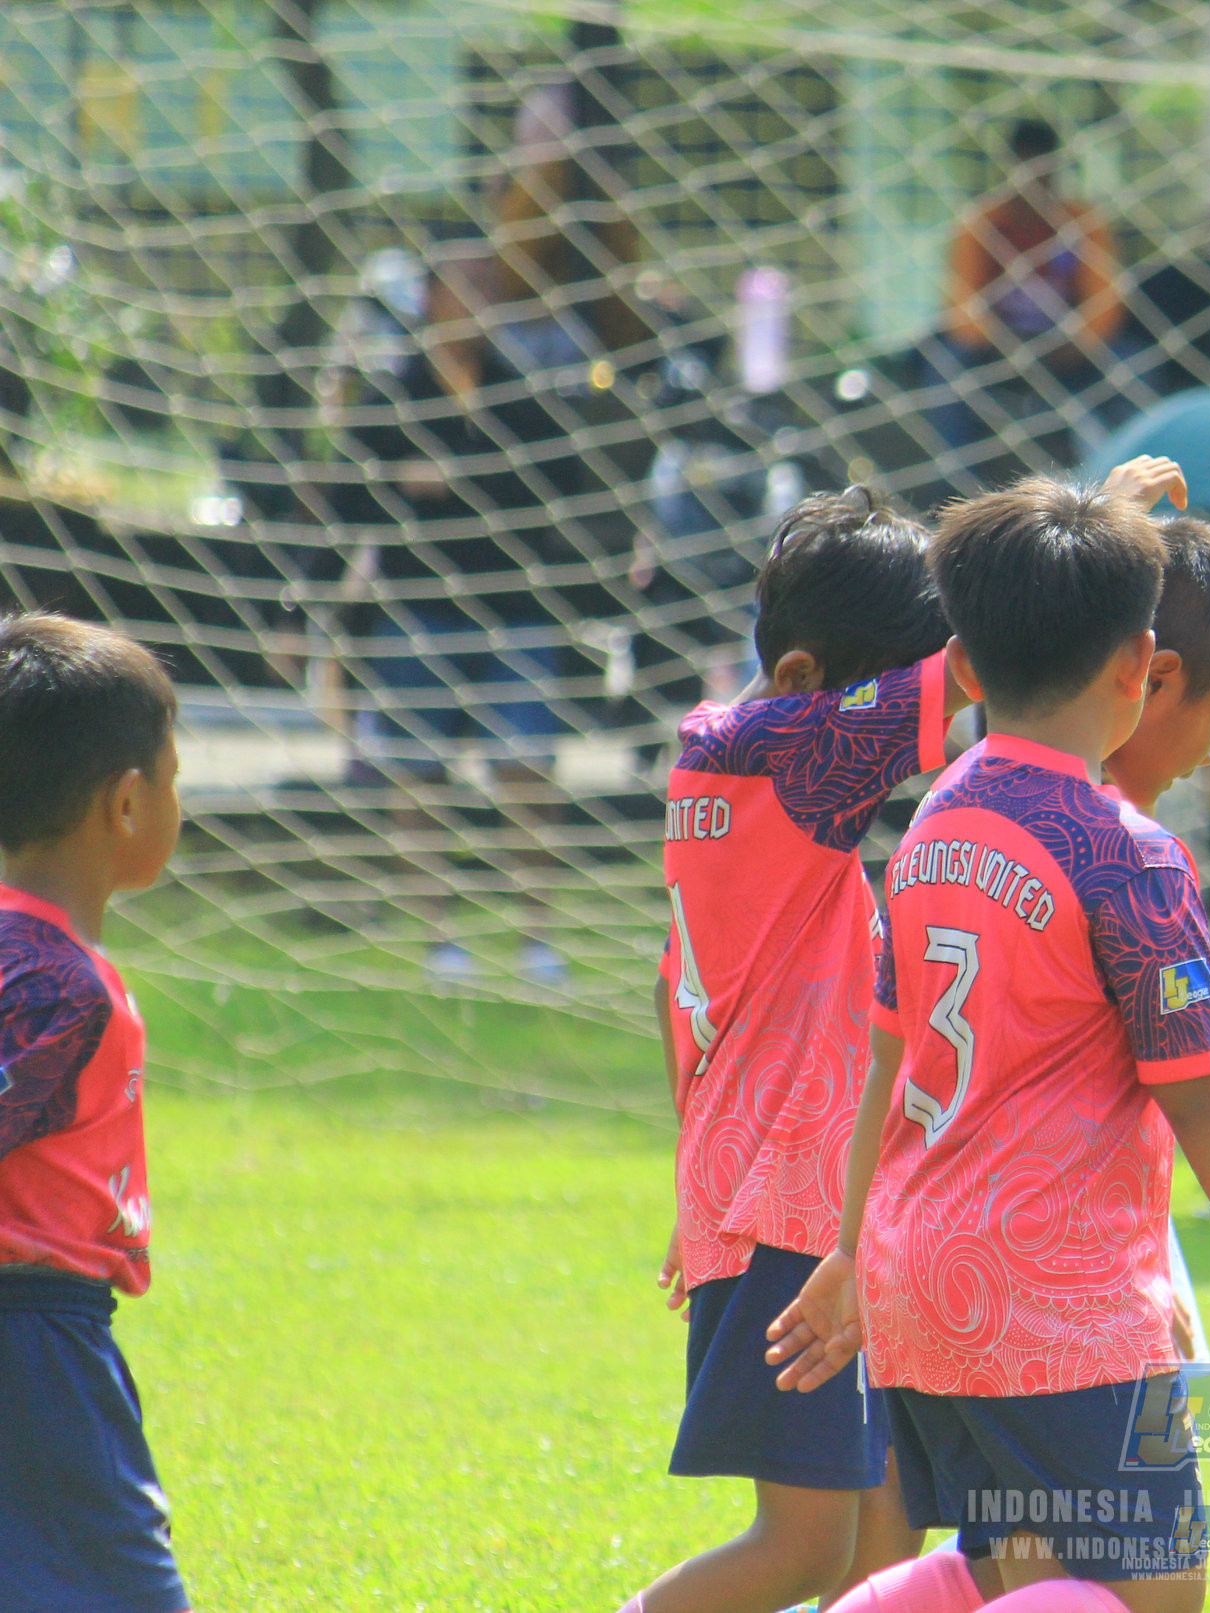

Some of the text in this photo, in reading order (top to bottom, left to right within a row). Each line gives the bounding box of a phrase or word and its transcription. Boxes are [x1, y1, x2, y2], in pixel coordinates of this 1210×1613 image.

[665, 796, 731, 841] UNITED
[975, 844, 1056, 932] UNITED
[904, 925, 980, 1150] 3
